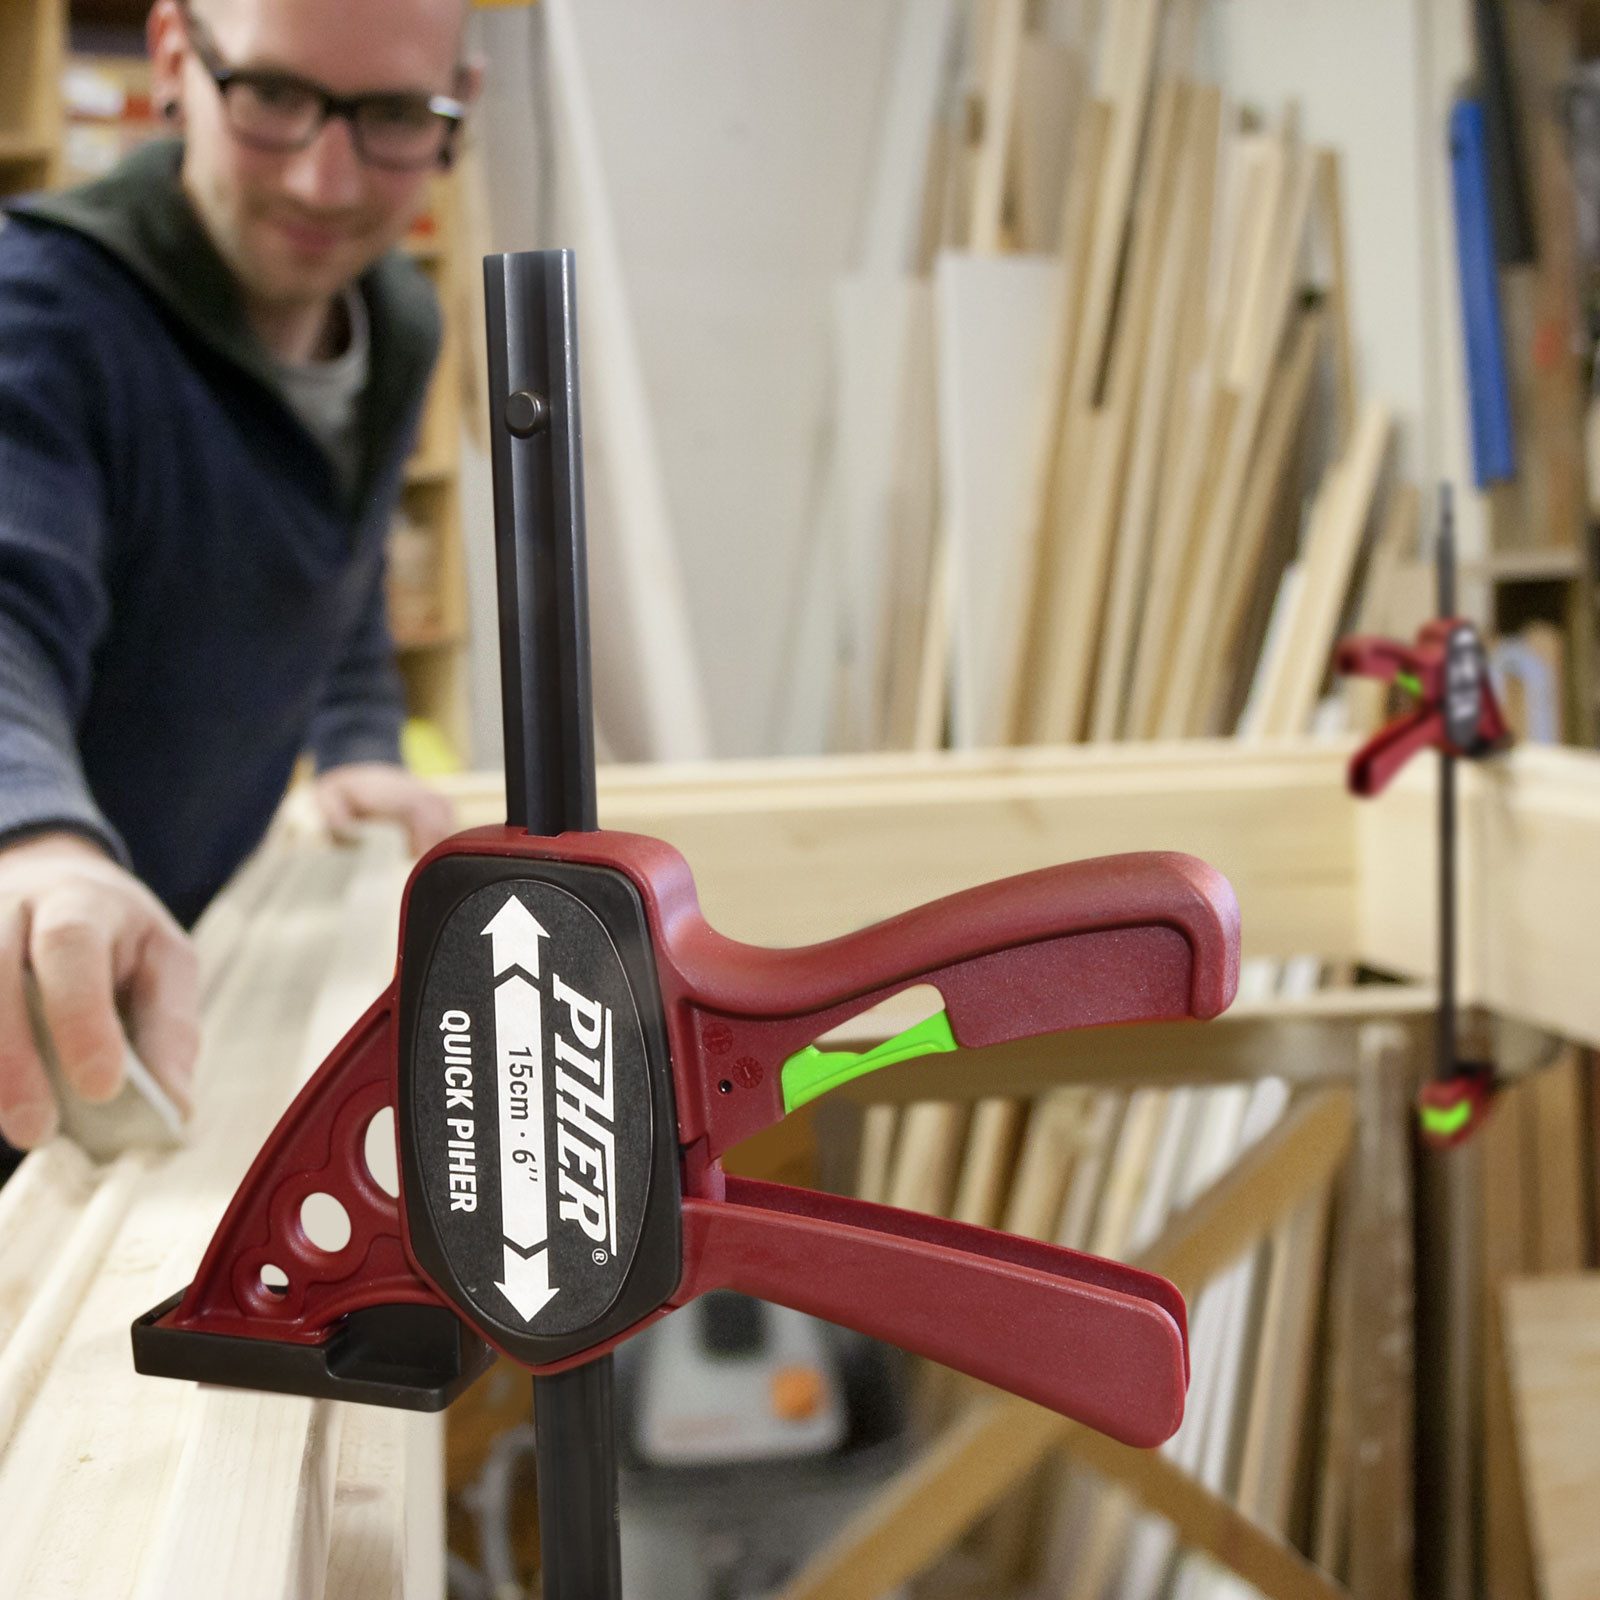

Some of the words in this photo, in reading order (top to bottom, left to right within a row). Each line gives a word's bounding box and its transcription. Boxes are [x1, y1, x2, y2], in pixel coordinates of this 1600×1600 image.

[439, 1009, 474, 1111] QUICK
[508, 1046, 534, 1120] 15cm
[446, 1117, 478, 1213] PIHER
